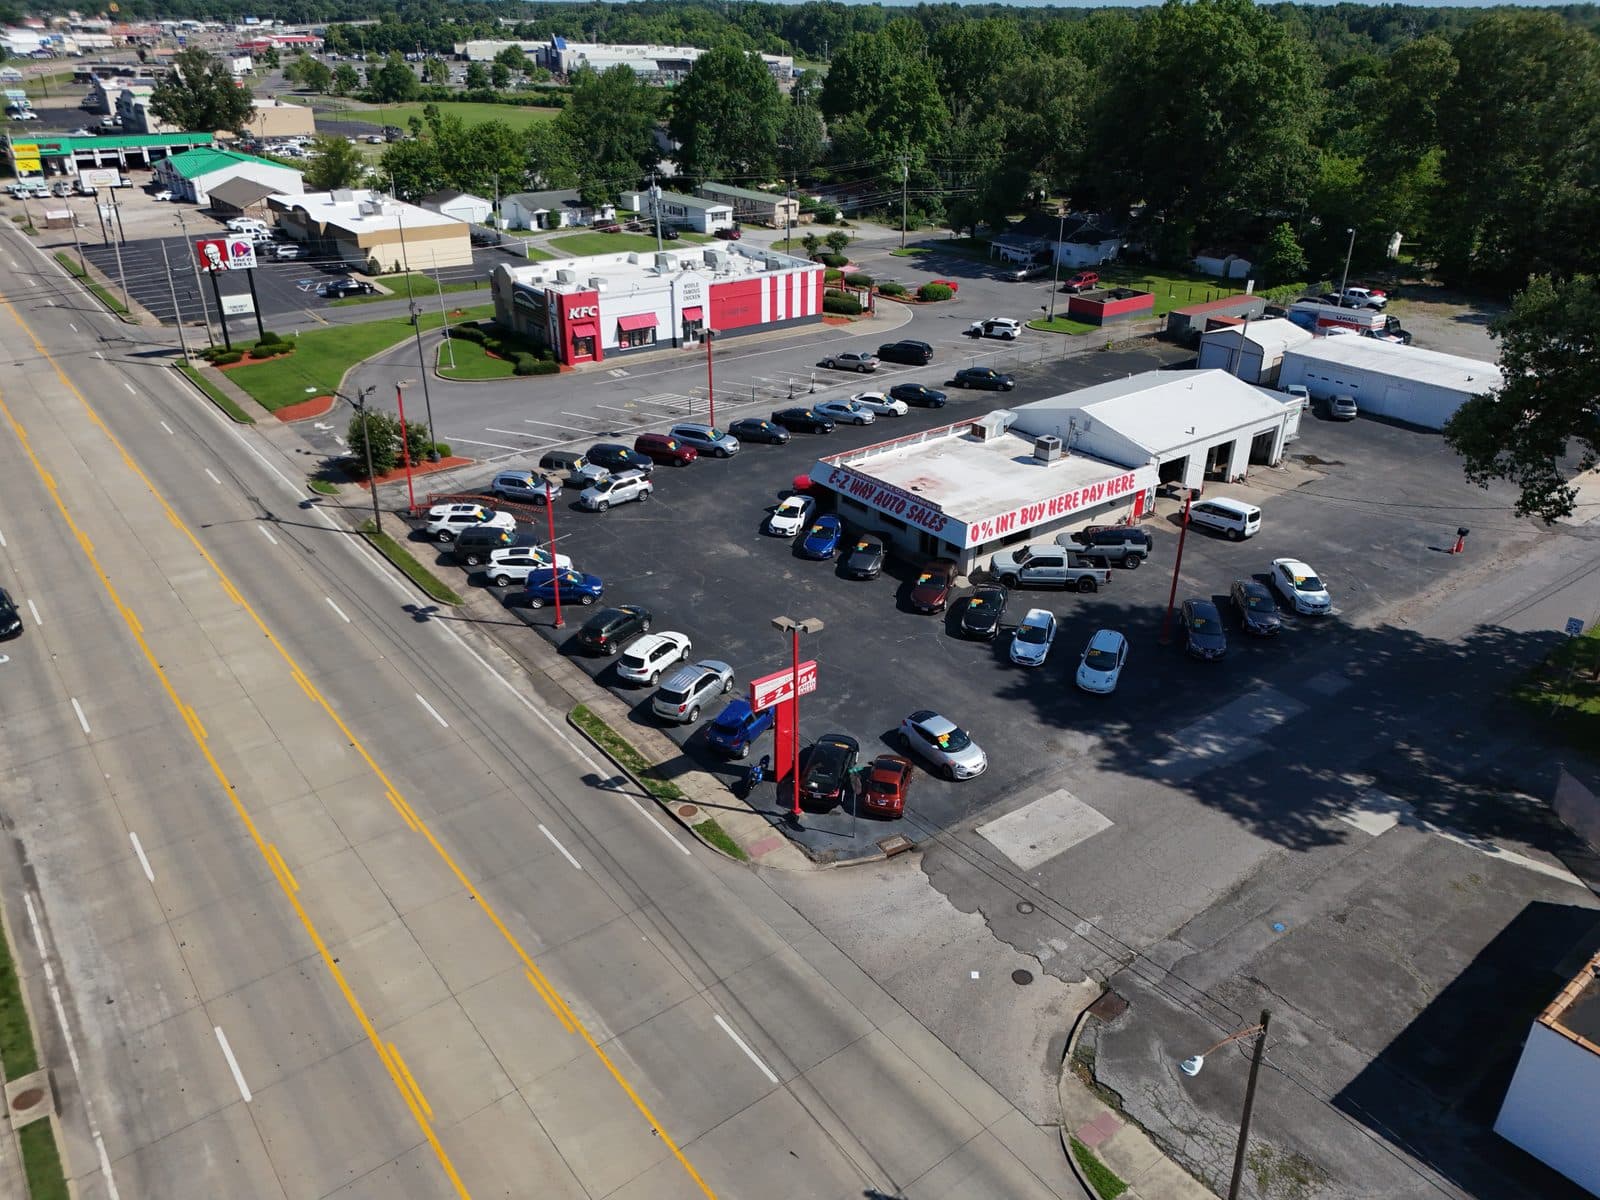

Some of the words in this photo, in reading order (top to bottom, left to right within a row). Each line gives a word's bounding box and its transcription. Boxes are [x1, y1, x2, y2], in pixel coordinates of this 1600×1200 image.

[568, 305, 598, 320] KFC
[828, 470, 850, 490] E-Z
[849, 478, 877, 500] WAY
[873, 491, 907, 515] AUTO
[906, 505, 948, 532] SALES
[995, 512, 1017, 534] INT
[1020, 503, 1046, 525] BUY
[1048, 491, 1079, 516] HERE
[1081, 483, 1105, 505] PAY
[1107, 473, 1136, 497] HERE
[757, 686, 784, 708] E-Z
